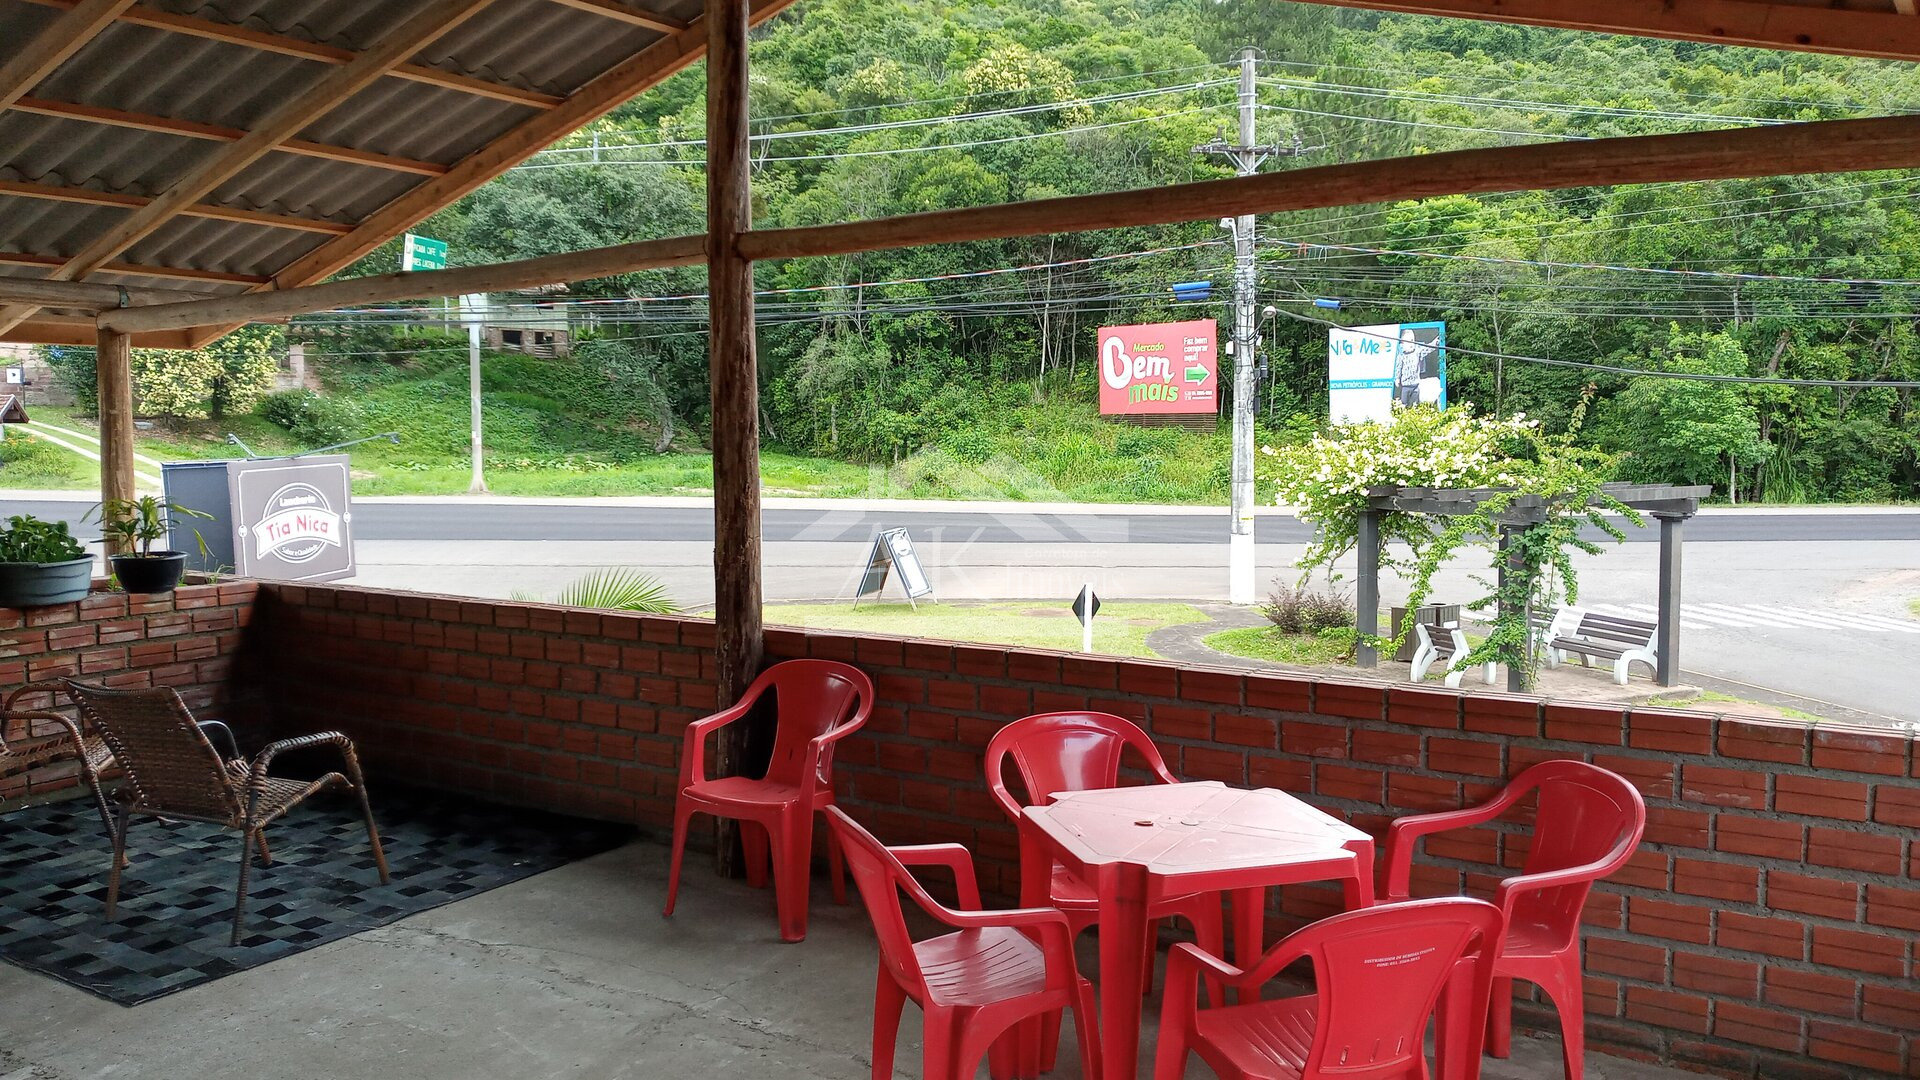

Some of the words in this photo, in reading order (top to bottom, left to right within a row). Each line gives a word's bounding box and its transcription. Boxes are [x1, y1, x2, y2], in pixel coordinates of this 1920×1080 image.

[1133, 342, 1165, 352] Mercado
[1183, 337, 1194, 345] Faz
[1194, 336, 1208, 344] bem
[1183, 345, 1209, 353] comprar
[1102, 336, 1176, 389] Bem
[1129, 382, 1179, 405] mais
[266, 521, 291, 541] Tia
[296, 514, 328, 533] Nica
